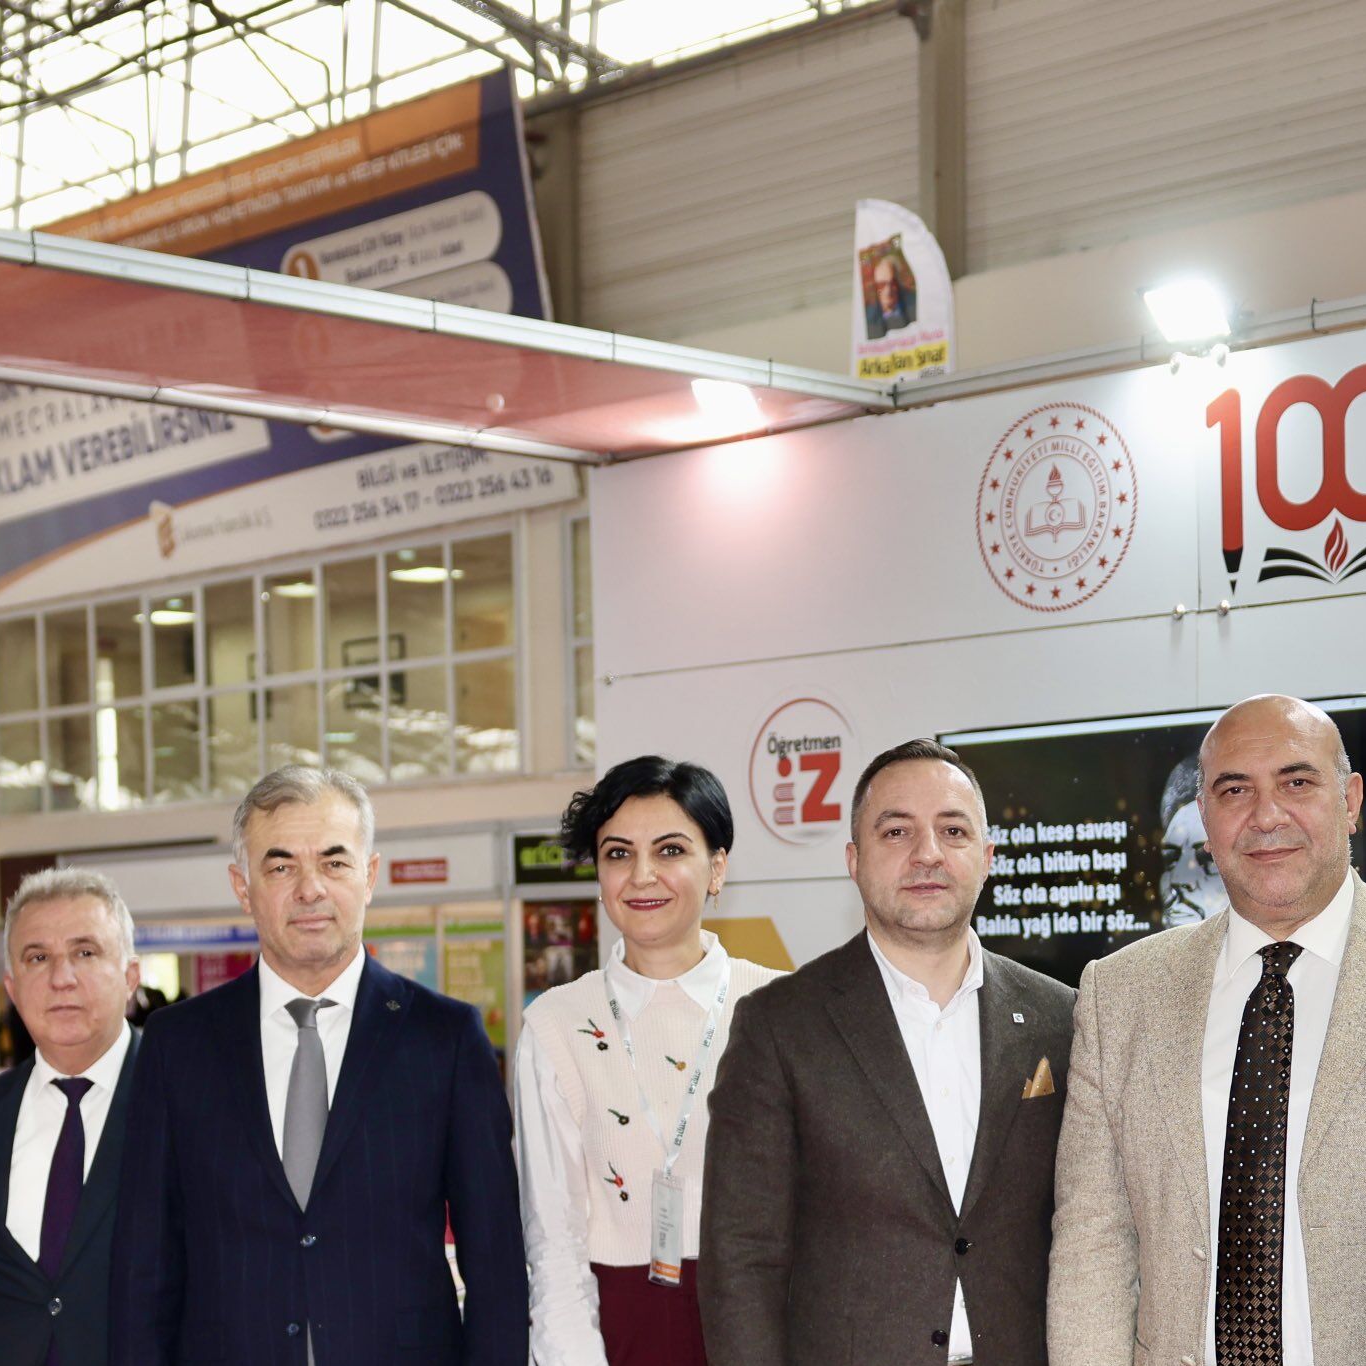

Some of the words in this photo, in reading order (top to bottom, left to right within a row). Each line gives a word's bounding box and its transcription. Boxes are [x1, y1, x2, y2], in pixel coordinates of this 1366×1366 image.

[356, 460, 395, 491] BİLGİ
[400, 466, 419, 482] ve
[767, 731, 841, 760] Öğretmen
[1010, 822, 1036, 845] ola
[1036, 821, 1075, 843] kese
[1076, 820, 1128, 845] savaşı
[1017, 852, 1042, 875] ola
[1043, 850, 1091, 874] bitüre
[1092, 848, 1128, 875] başı
[993, 883, 1021, 906] Söz
[1022, 881, 1048, 905] ola
[1049, 880, 1095, 908] agulu
[1096, 882, 1122, 906] aşı
[1021, 911, 1052, 940] yağ
[1053, 911, 1078, 934] ide
[1080, 910, 1105, 933] bir
[1106, 908, 1150, 932] söz...
